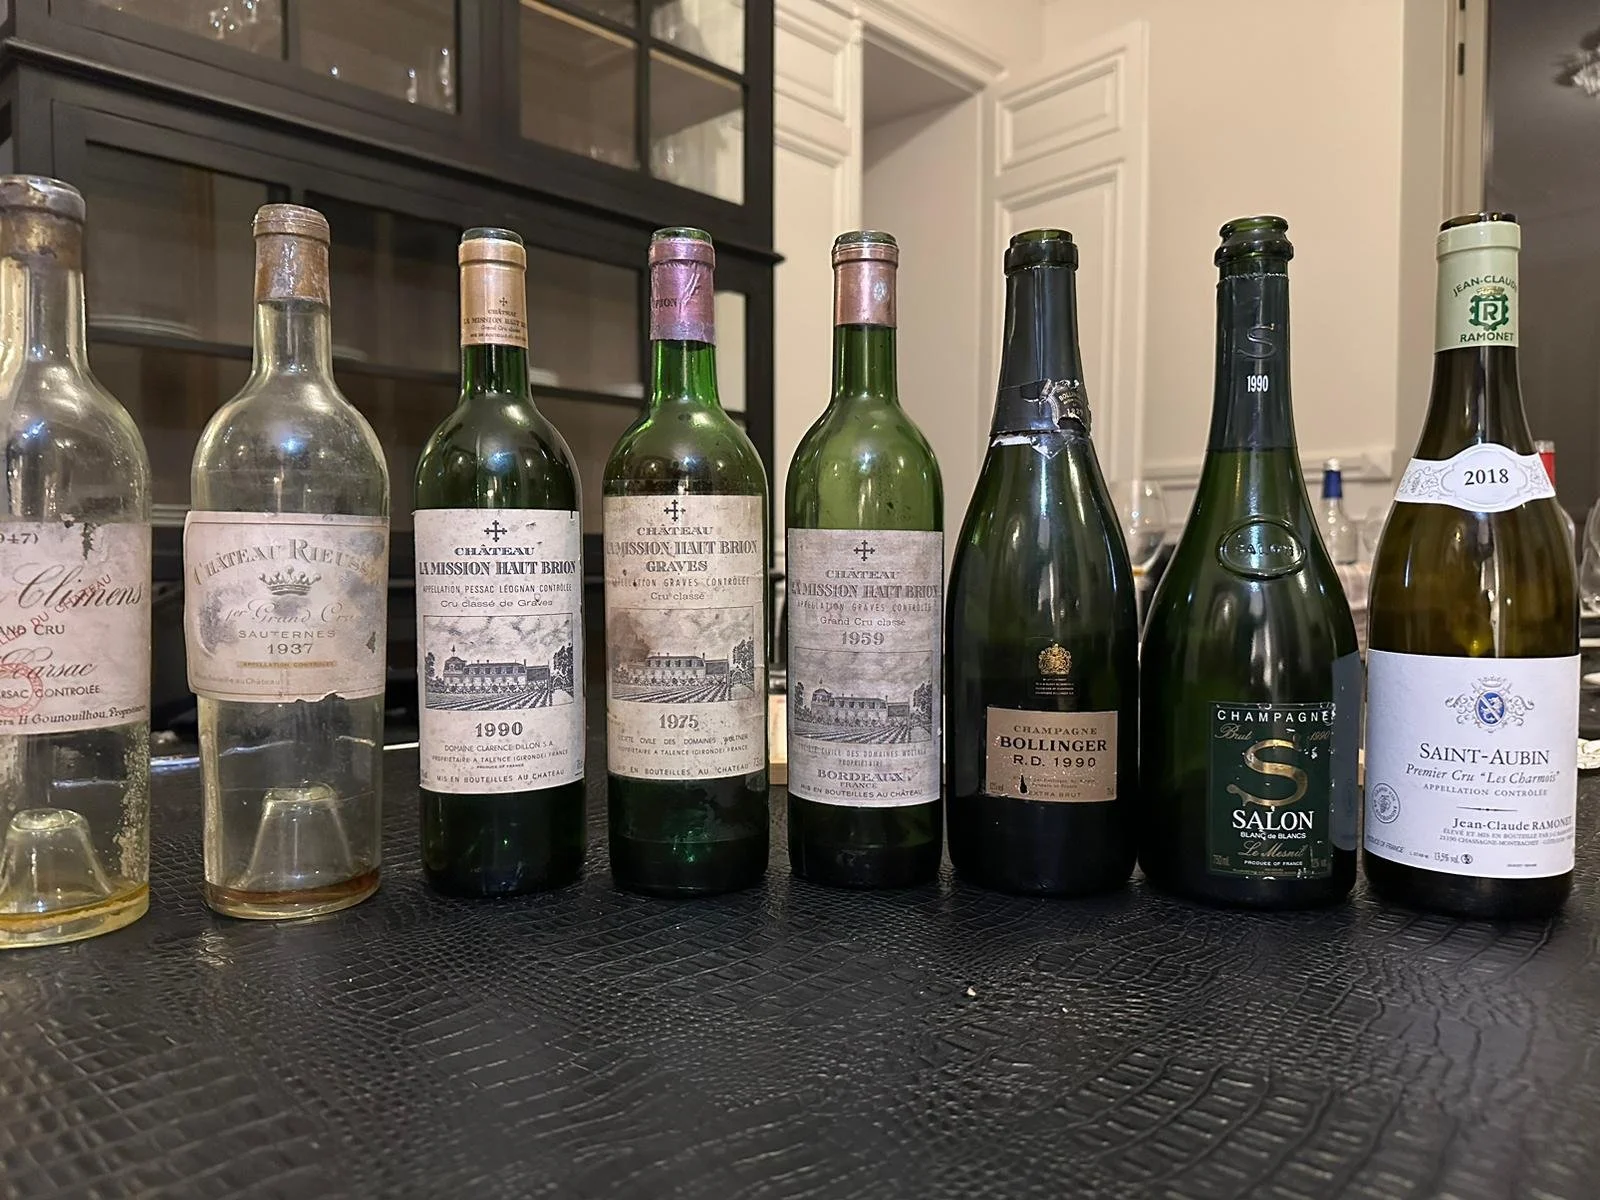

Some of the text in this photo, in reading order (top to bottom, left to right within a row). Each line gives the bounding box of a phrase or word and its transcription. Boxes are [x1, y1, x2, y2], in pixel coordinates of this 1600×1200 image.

[1482, 303, 1498, 321] R
[1460, 332, 1514, 342] RAMONET
[1246, 375, 1269, 391] 1990
[1464, 468, 1509, 485] 2018
[454, 544, 535, 556] CHÂTEAU
[720, 541, 757, 554] BRION
[430, 561, 492, 576] MISSION
[496, 561, 539, 576] HAUT
[541, 560, 577, 576] BRION
[646, 561, 708, 572] GRAVES
[465, 585, 495, 594] PESSAC
[664, 578, 698, 588] GRAVES
[650, 592, 669, 600] Cru
[904, 585, 938, 599] BRION
[440, 600, 459, 608] Cru
[499, 599, 514, 607] de
[819, 616, 850, 626] Grand
[854, 617, 873, 626] Cru
[34, 624, 65, 636] CRU
[238, 631, 336, 639] SAUTERNES
[267, 643, 313, 655] 1937
[659, 713, 699, 730] 1975
[1217, 709, 1329, 723] CHAMPAGNE
[474, 721, 524, 738] 1990
[1013, 724, 1098, 736] CHAMPAGNE
[1214, 723, 1253, 741] Brut
[444, 744, 473, 752] DOMAINE
[477, 743, 512, 752] CLARENCE
[1000, 735, 1107, 752] BOLLINGER
[1013, 754, 1096, 768] R.D. 1990
[1420, 743, 1550, 766] SAINT-AUBIN
[817, 769, 904, 782] BORDEAUX
[1226, 737, 1310, 807] S
[1406, 763, 1446, 780] Premier
[1451, 769, 1474, 782] Cru
[840, 781, 877, 789] FRANCE
[1423, 783, 1488, 796] APPELLATION
[826, 789, 874, 798] BOUTEILLES
[1232, 809, 1314, 831] SALON
[1452, 817, 1529, 831] Jean-Claude
[1240, 831, 1266, 840] BLANC
[1278, 832, 1306, 840] BLANCS
